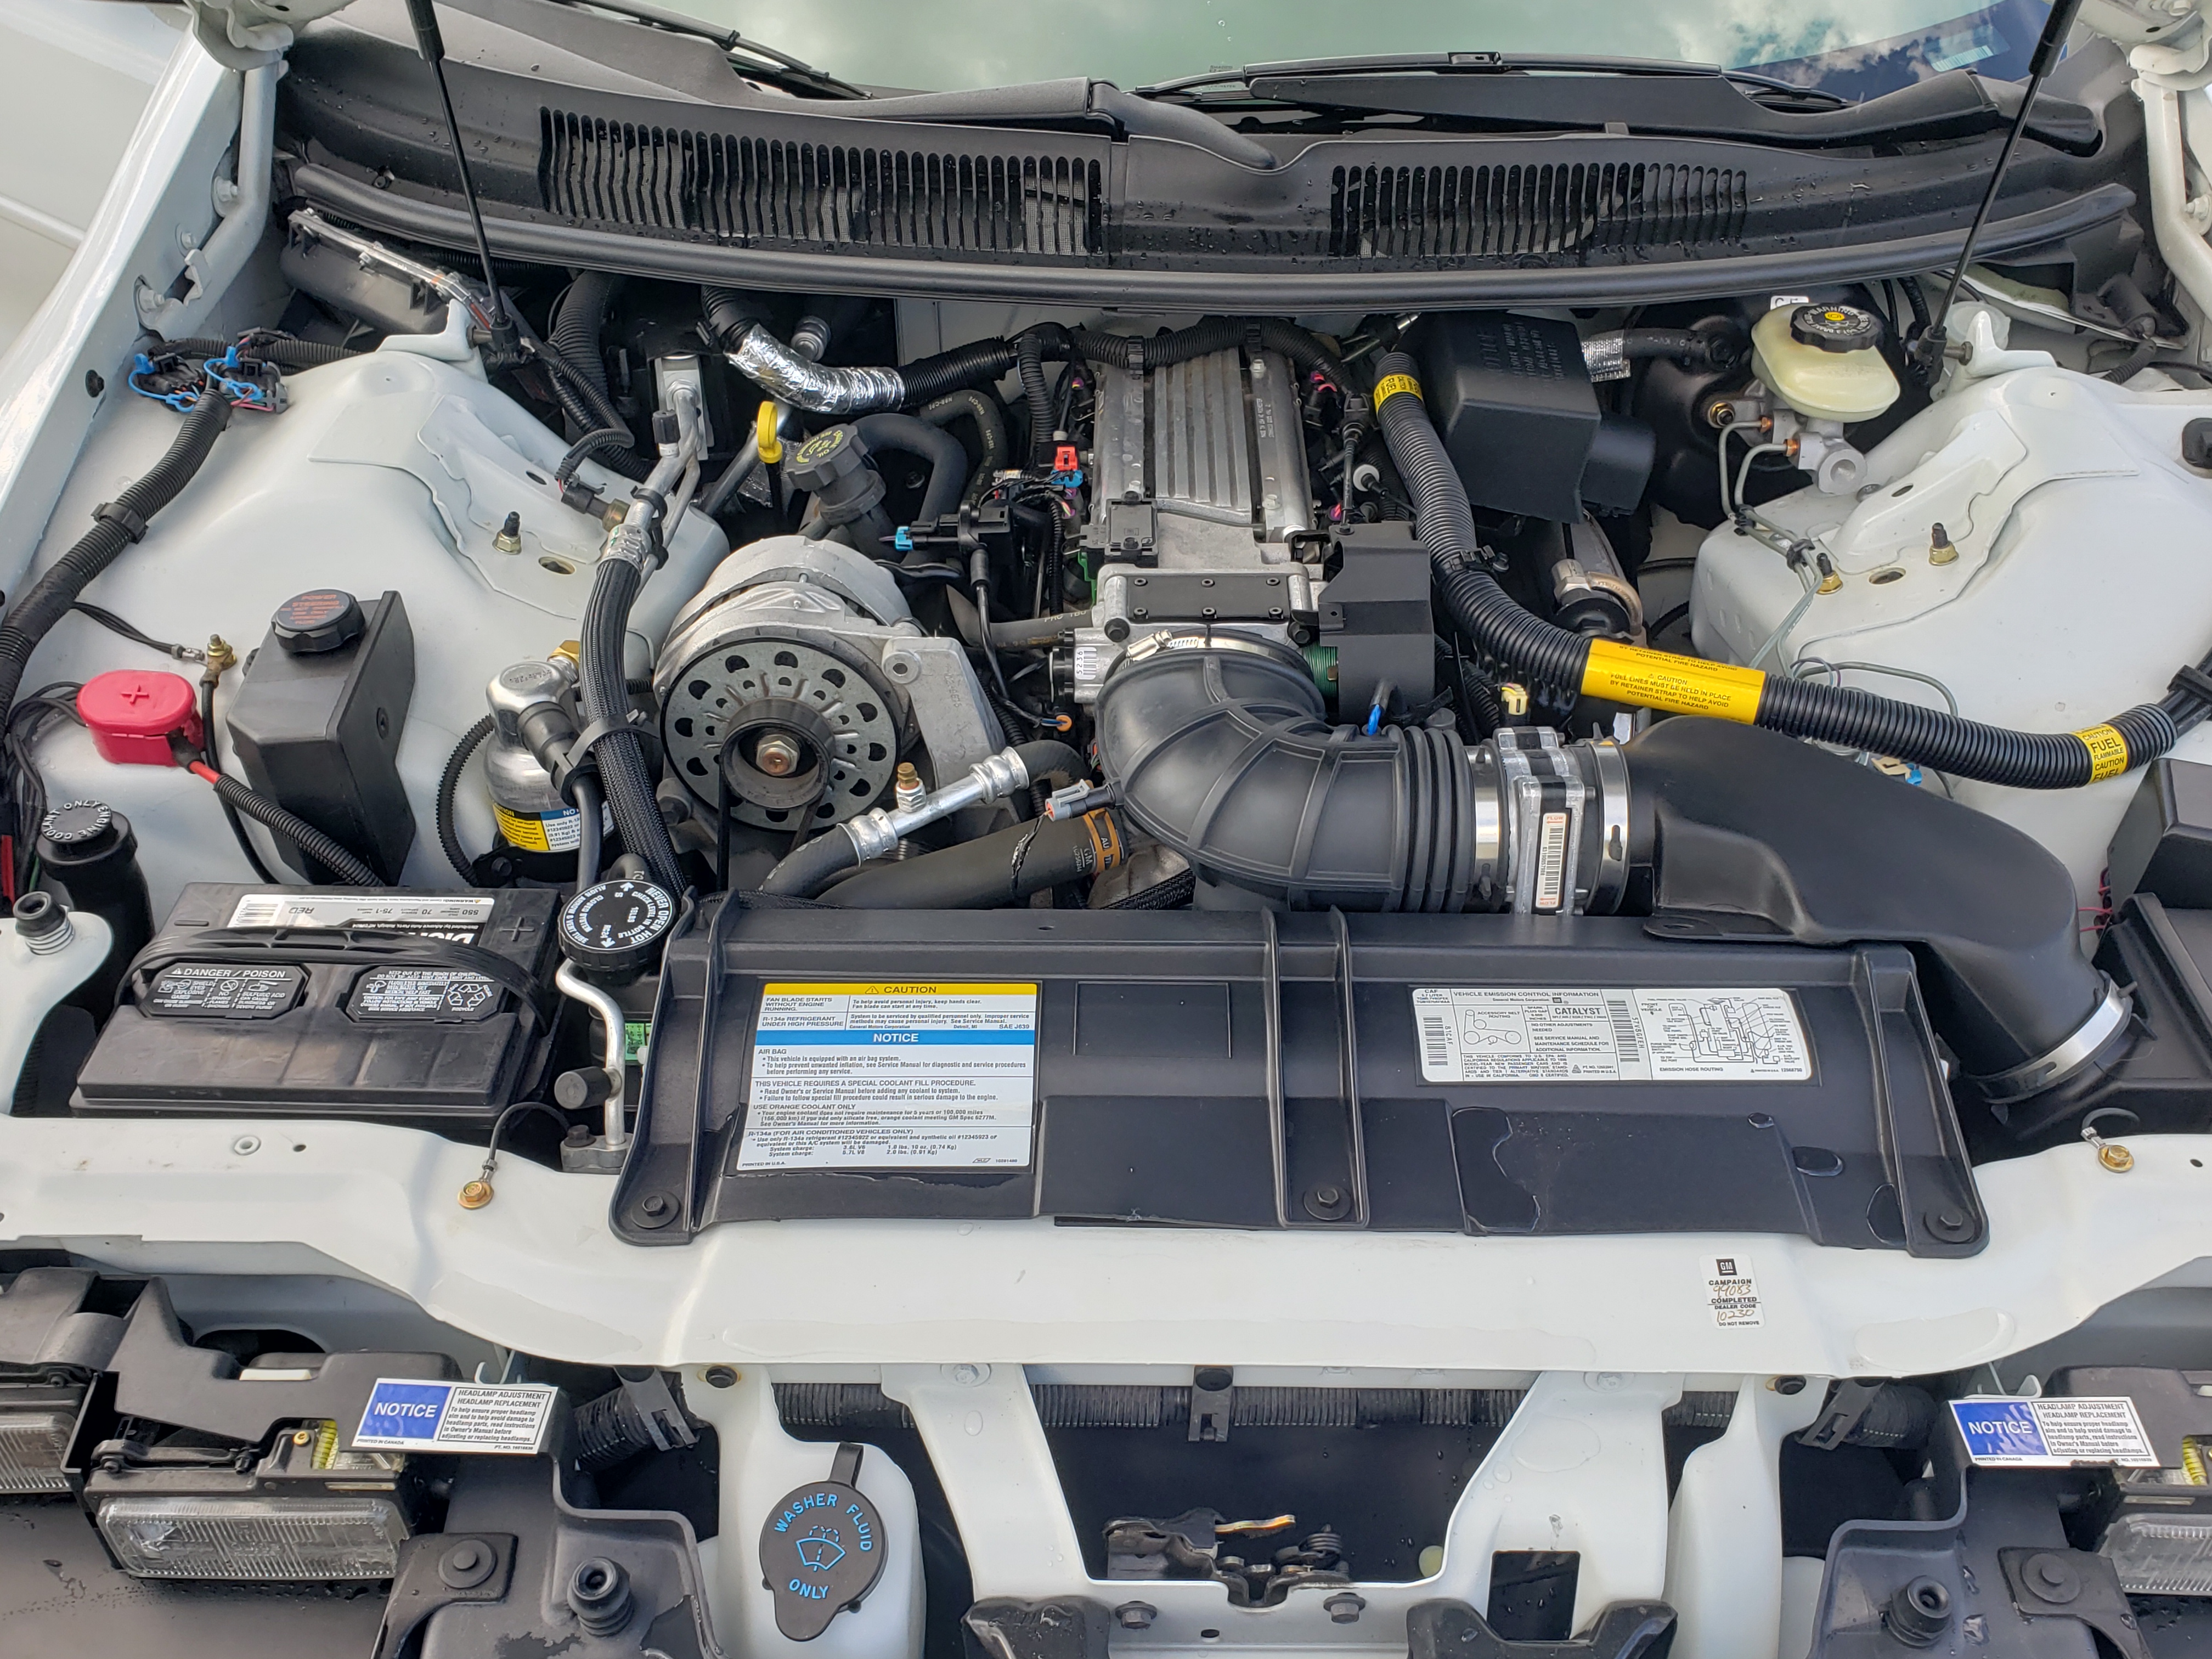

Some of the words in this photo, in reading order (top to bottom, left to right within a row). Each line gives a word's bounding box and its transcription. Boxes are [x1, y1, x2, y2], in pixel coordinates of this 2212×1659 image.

[1657, 675, 1688, 685] CAUTION
[1620, 682, 1654, 693] RETAINER
[1655, 689, 1677, 697] STRAP
[1707, 699, 1729, 708] AVOID
[1629, 676, 1649, 685] LINES
[1680, 686, 1699, 695] HELD
[1709, 692, 1731, 701] PLACE
[1627, 690, 1663, 702] POTENTIAL
[1681, 701, 1709, 710] HAZARD
[2083, 729, 2114, 740] CAUTION
[2090, 737, 2121, 753] FUEL
[2094, 747, 2123, 760] FLAMMABLE
[2095, 757, 2124, 770] CAUTION
[64, 800, 101, 809] ONLY
[42, 809, 73, 839] COOLANT
[78, 806, 111, 837] ENGINE
[1084, 848, 1093, 865] GM
[645, 887, 669, 909] NEVER
[650, 911, 669, 931] OPEN
[618, 926, 645, 938] BOTTLE
[631, 931, 652, 944] HOT
[183, 968, 231, 977] DANGER
[873, 1033, 919, 1042] NOTICE
[1632, 1017, 1645, 1048] 57V8GFEH
[1720, 1262, 1733, 1270] GM
[458, 1389, 498, 1397] HEADLAMP
[498, 1391, 546, 1400] ADJUSTMENT
[374, 1402, 438, 1418] NOTICE
[493, 1400, 541, 1408] REPLACEMENT
[2078, 1402, 2124, 1410] ADJUSTMENT
[1968, 1421, 2033, 1435] NOTICE
[774, 1493, 838, 1533] WASHER
[846, 1503, 873, 1551] FLUID
[789, 1578, 829, 1599] ONLY
